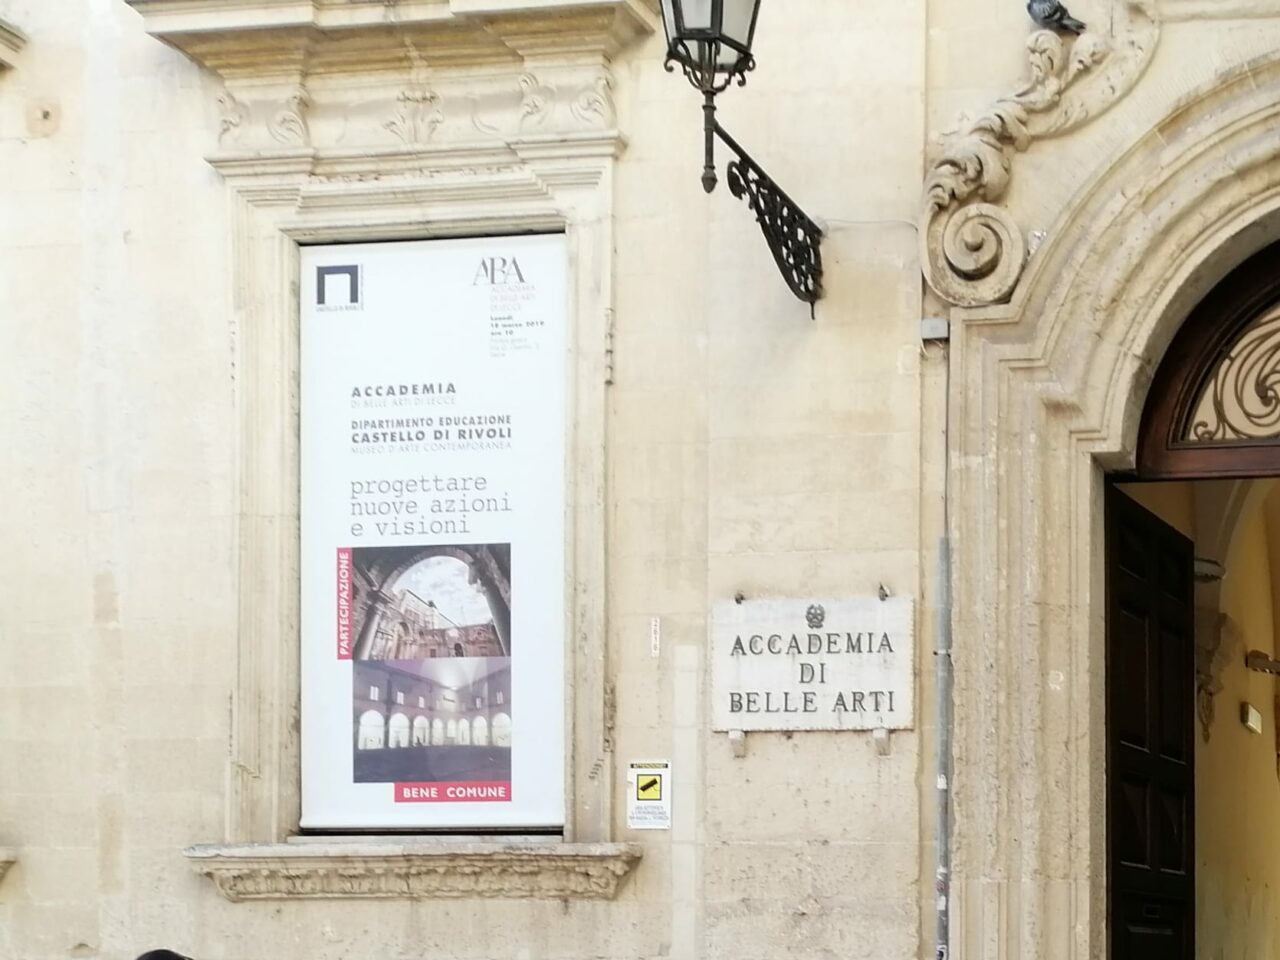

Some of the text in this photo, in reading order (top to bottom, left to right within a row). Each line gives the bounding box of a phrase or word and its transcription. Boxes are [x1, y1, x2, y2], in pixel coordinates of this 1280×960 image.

[351, 383, 457, 398] ACCADEMIA
[351, 415, 512, 430] DIPARTIMENTO EDUCAZIONE
[351, 427, 512, 443] CASTELLO DI RIVOLI
[350, 474, 488, 499] progettare
[350, 492, 513, 516] nuove azioni
[350, 515, 471, 537] e visioni
[340, 551, 350, 655] PARTECIPAZIONE
[730, 632, 895, 656] ACCADEMIA
[799, 662, 827, 684] DI
[729, 691, 896, 713] BELLE ARTI
[402, 786, 506, 798] BENE COMUNE
